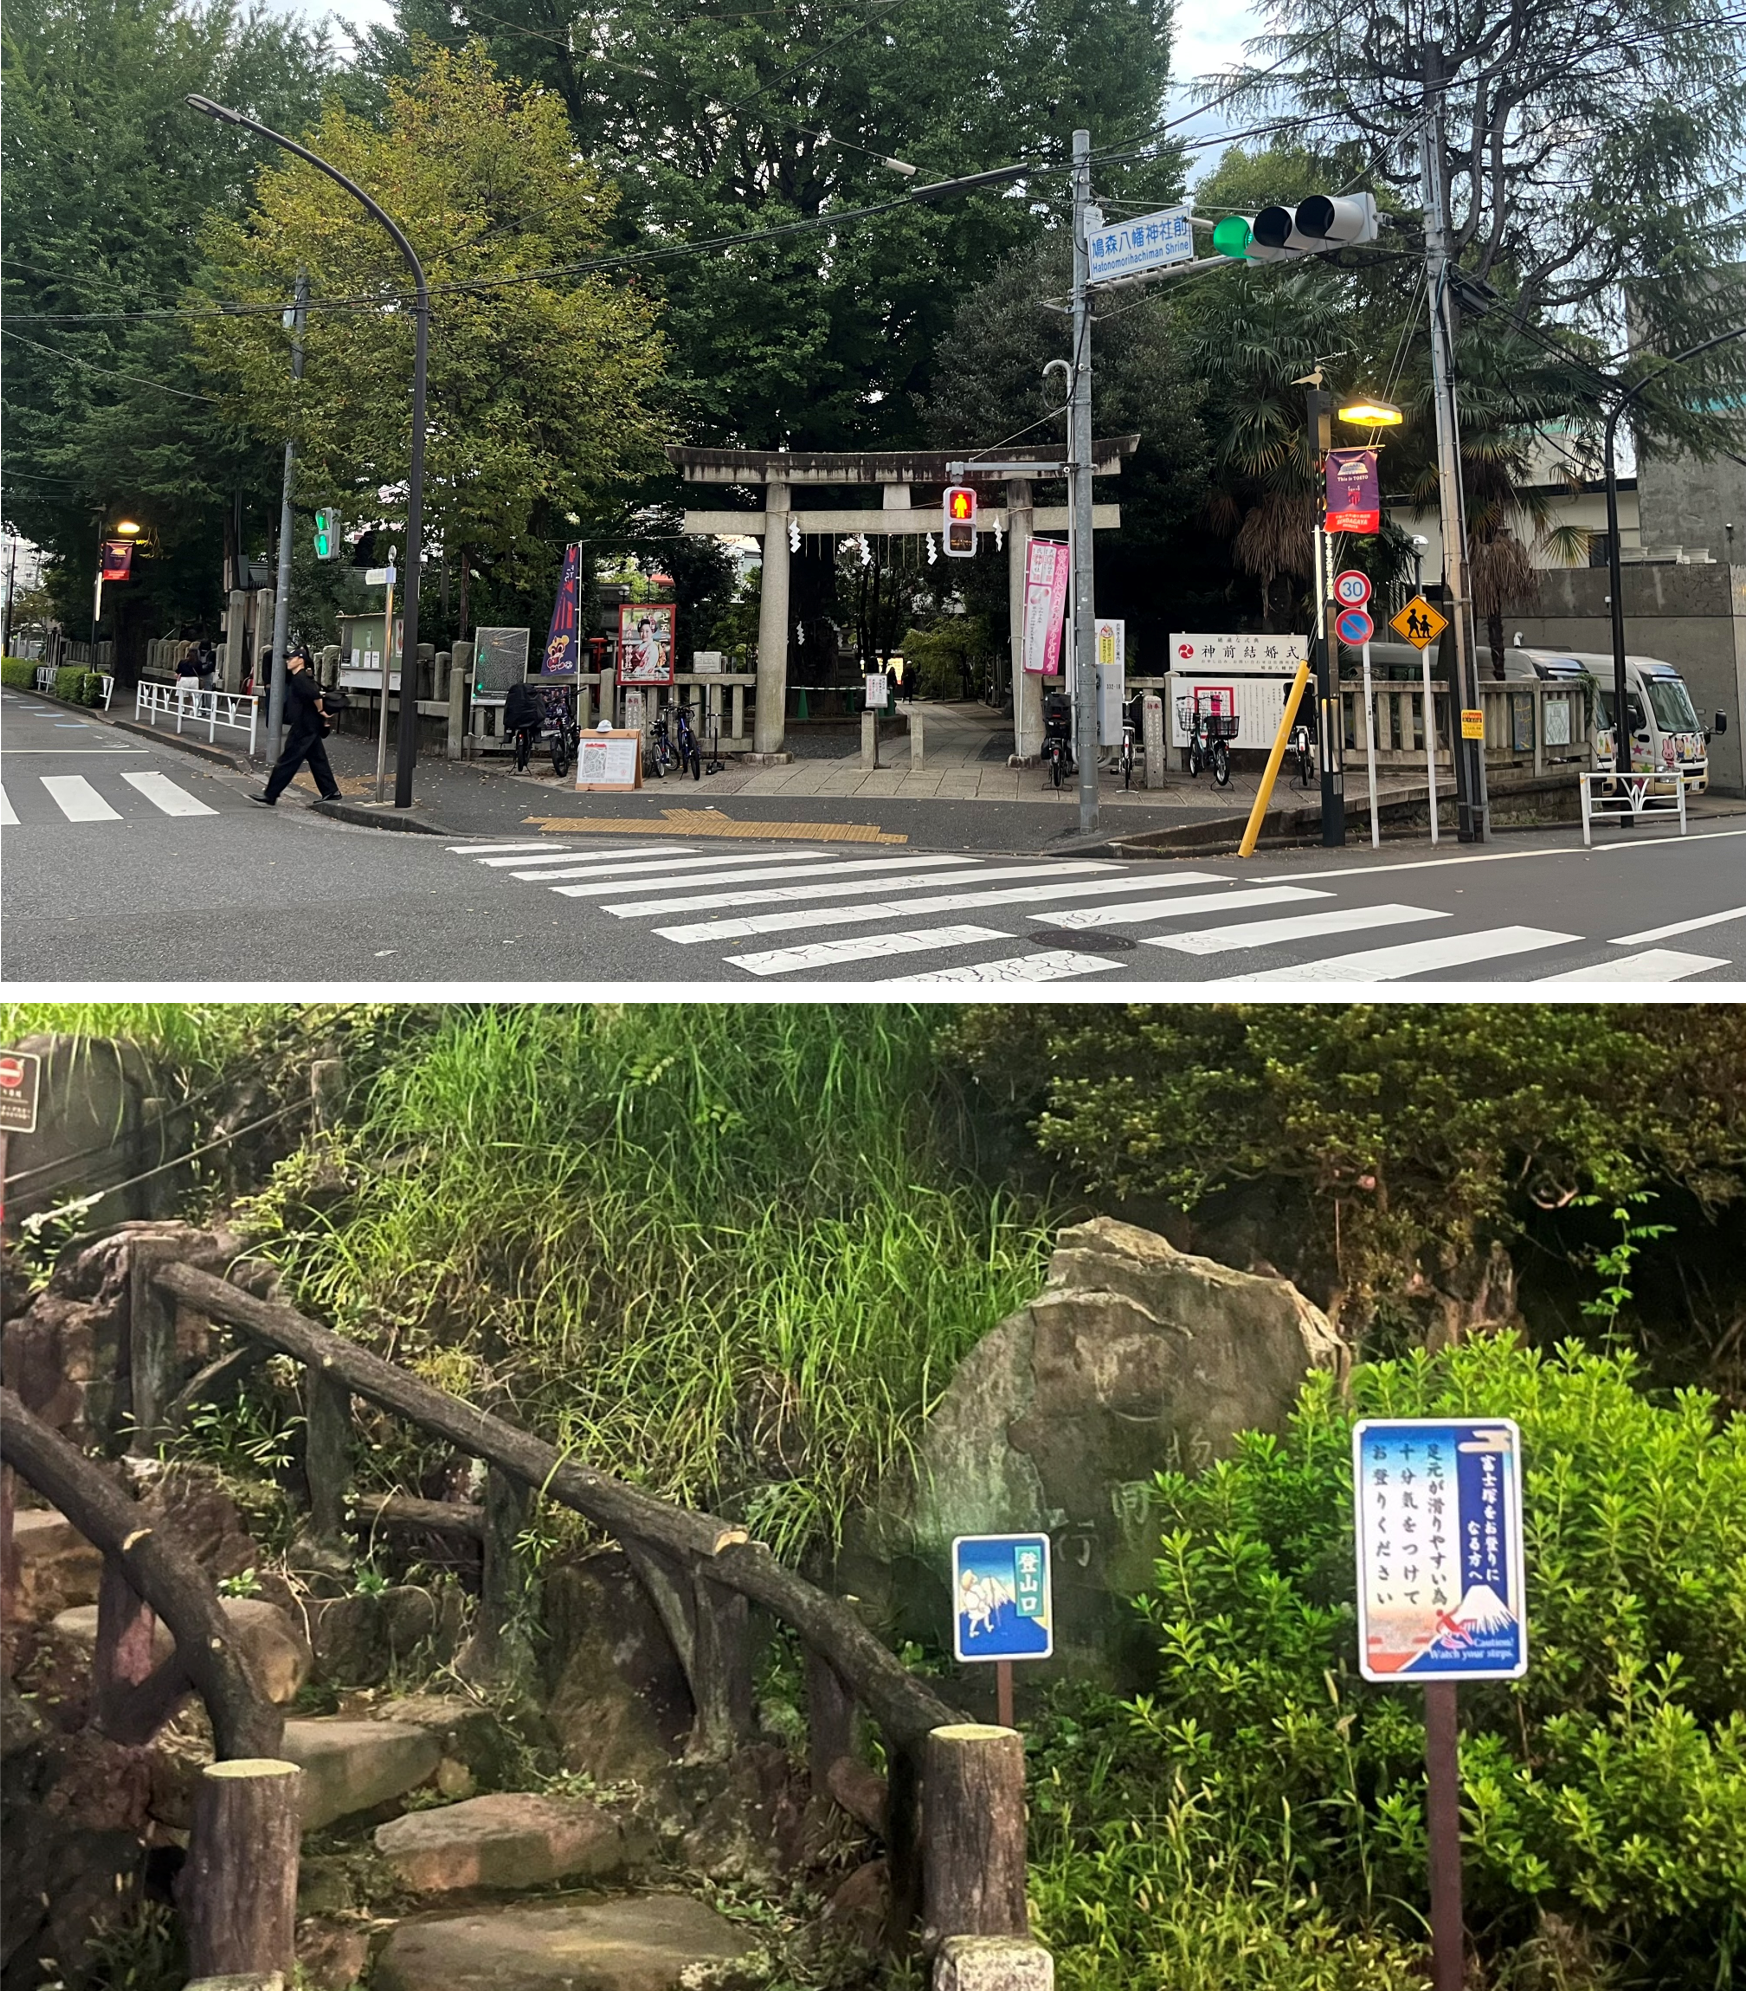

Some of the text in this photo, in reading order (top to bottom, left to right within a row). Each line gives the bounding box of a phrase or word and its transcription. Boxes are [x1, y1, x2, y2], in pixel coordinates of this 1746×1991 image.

[1092, 215, 1188, 258] 鳩森八幡神社前
[1092, 241, 1189, 274] Hatonomorihachiman Shrine
[1336, 517, 1368, 526] SENDAGAYA
[1342, 581, 1363, 598] 30
[659, 612, 670, 642] 七五三
[1201, 645, 1300, 659] 神前結婚式
[1373, 1443, 1394, 1605] お登りください
[1399, 1443, 1421, 1605] 十分気をつけて
[1426, 1443, 1449, 1606] 足元が滑りやすい為
[1468, 1520, 1484, 1580] なる方へ
[1019, 1551, 1038, 1611] 登山口
[1430, 1648, 1461, 1660] Watch
[1462, 1649, 1485, 1661] your
[1474, 1636, 1514, 1648] Caution!
